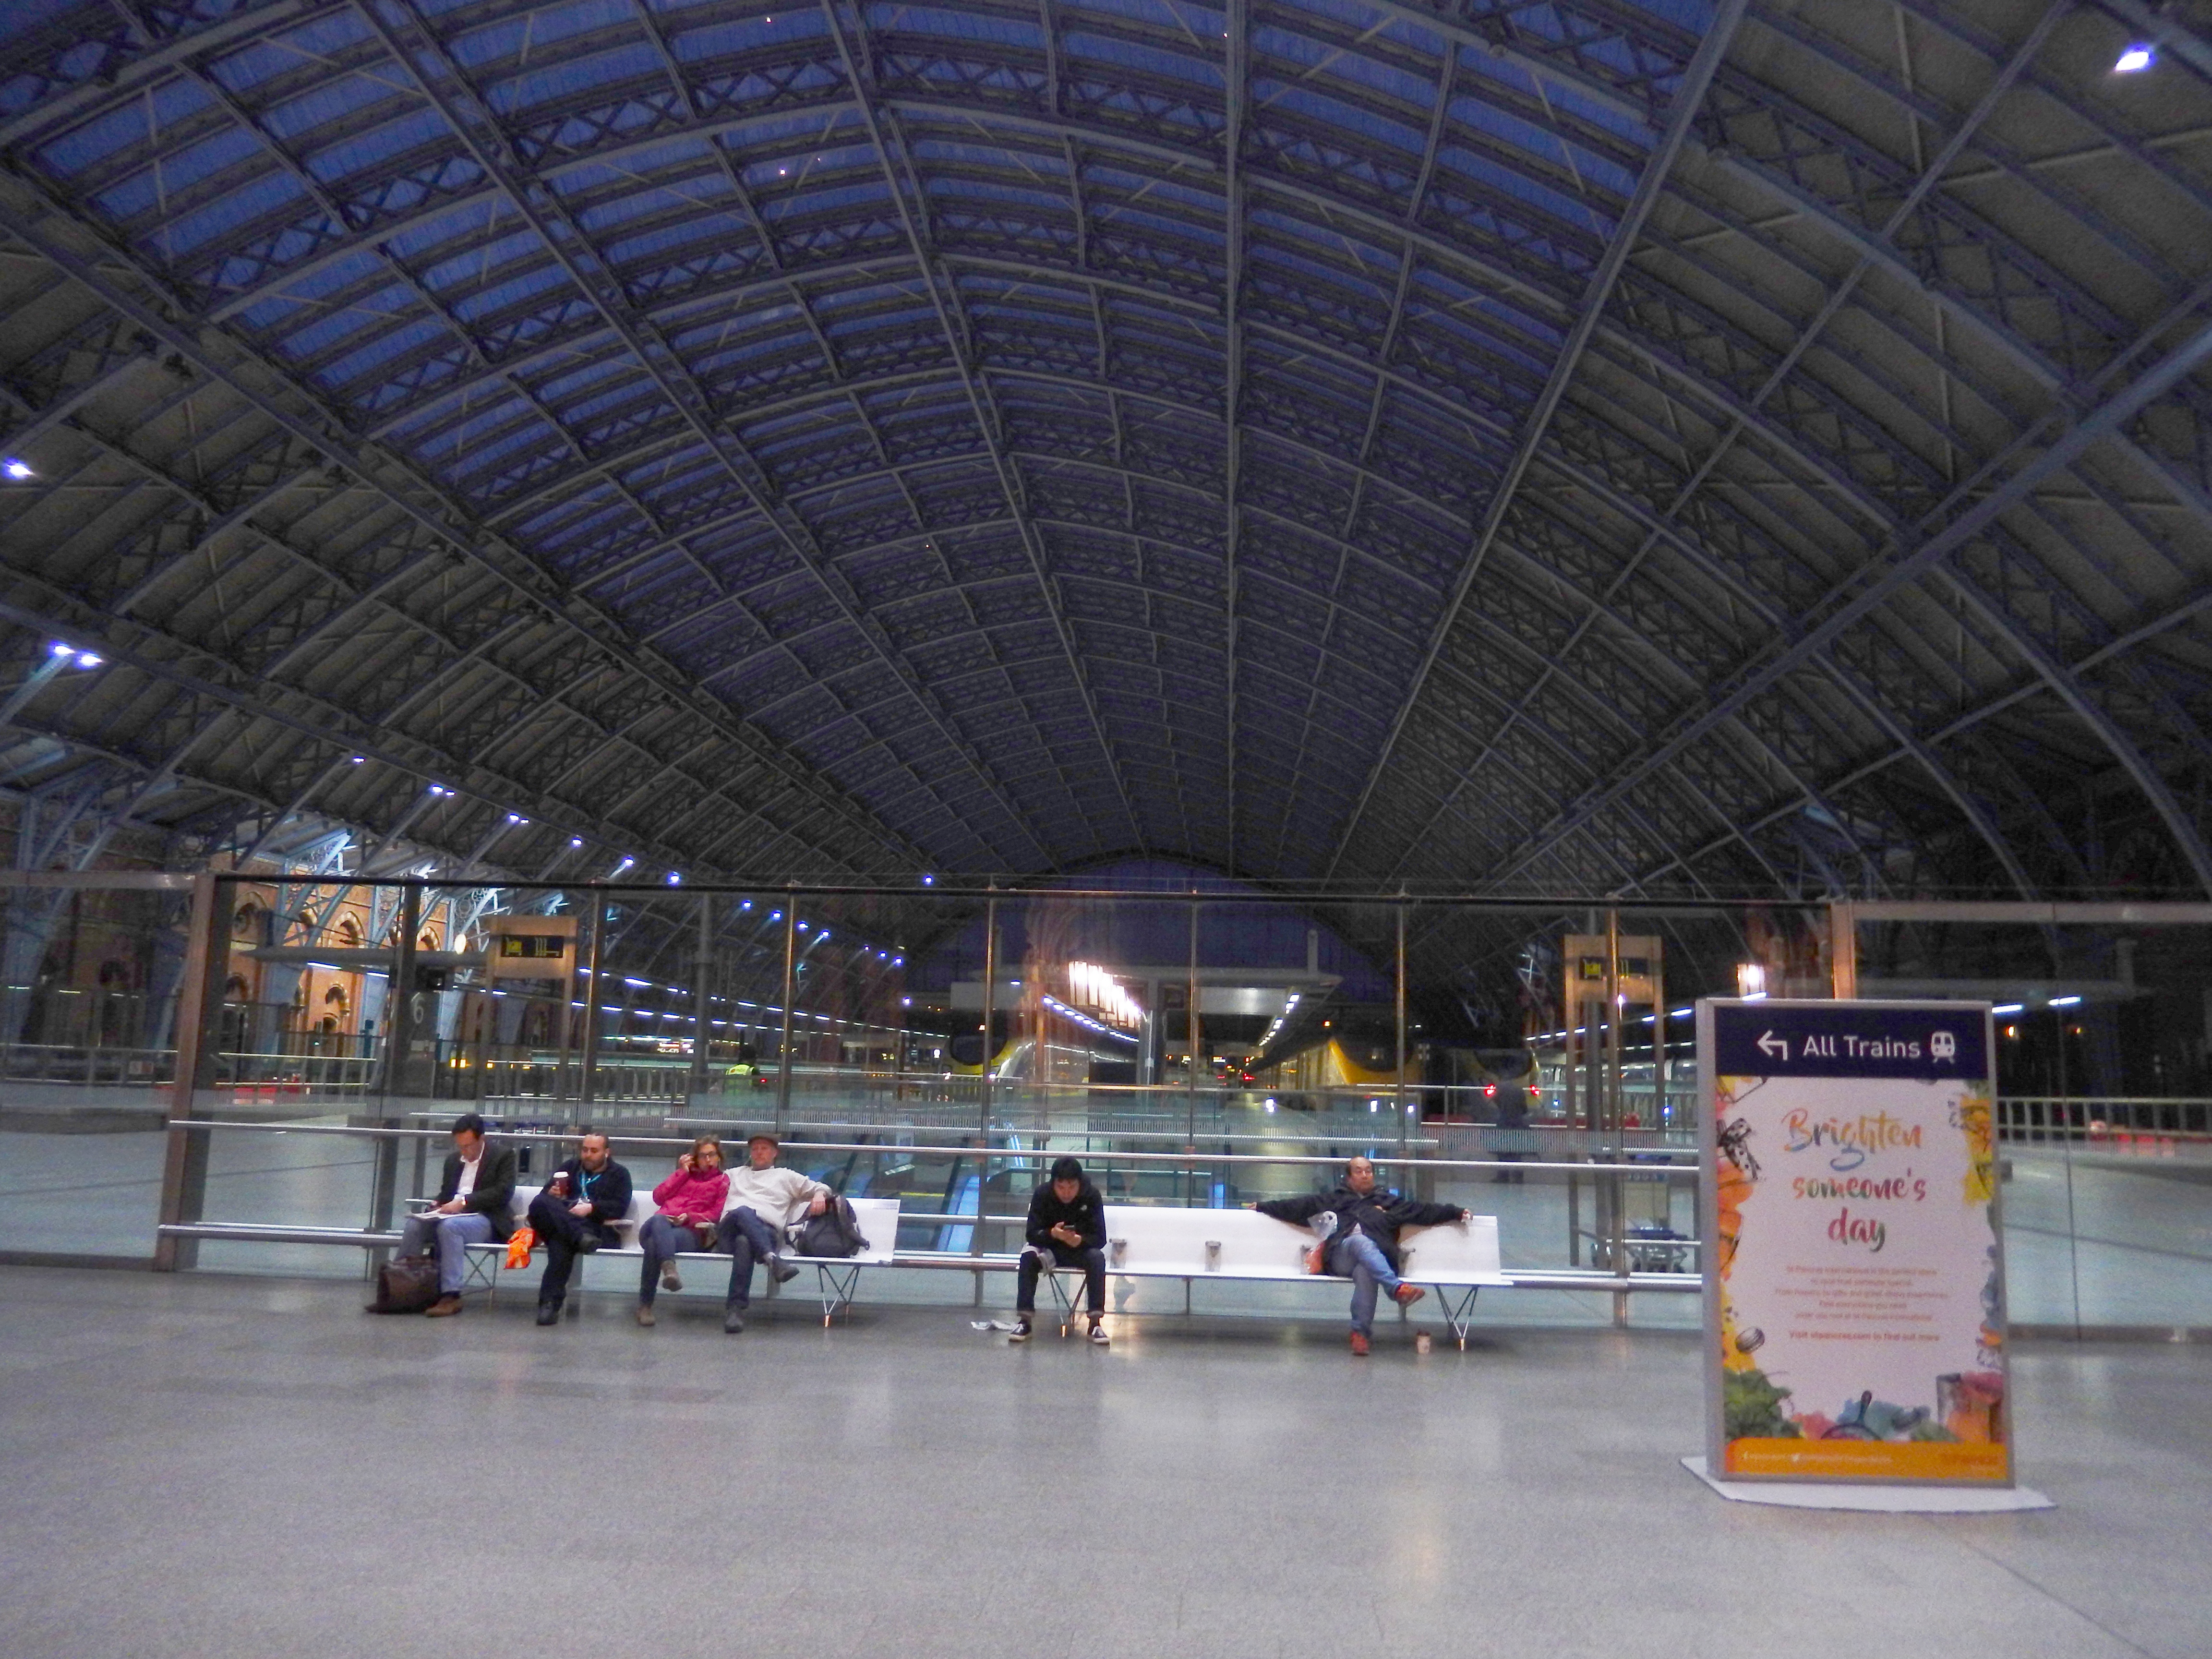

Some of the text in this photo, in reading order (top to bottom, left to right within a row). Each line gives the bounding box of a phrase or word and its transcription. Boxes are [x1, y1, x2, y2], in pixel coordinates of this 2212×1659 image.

[1803, 1035, 1920, 1058] All Trains
[1781, 1108, 1921, 1171] Brighten
[1792, 1167, 1926, 1201] someone's
[1828, 1206, 1885, 1252] day
